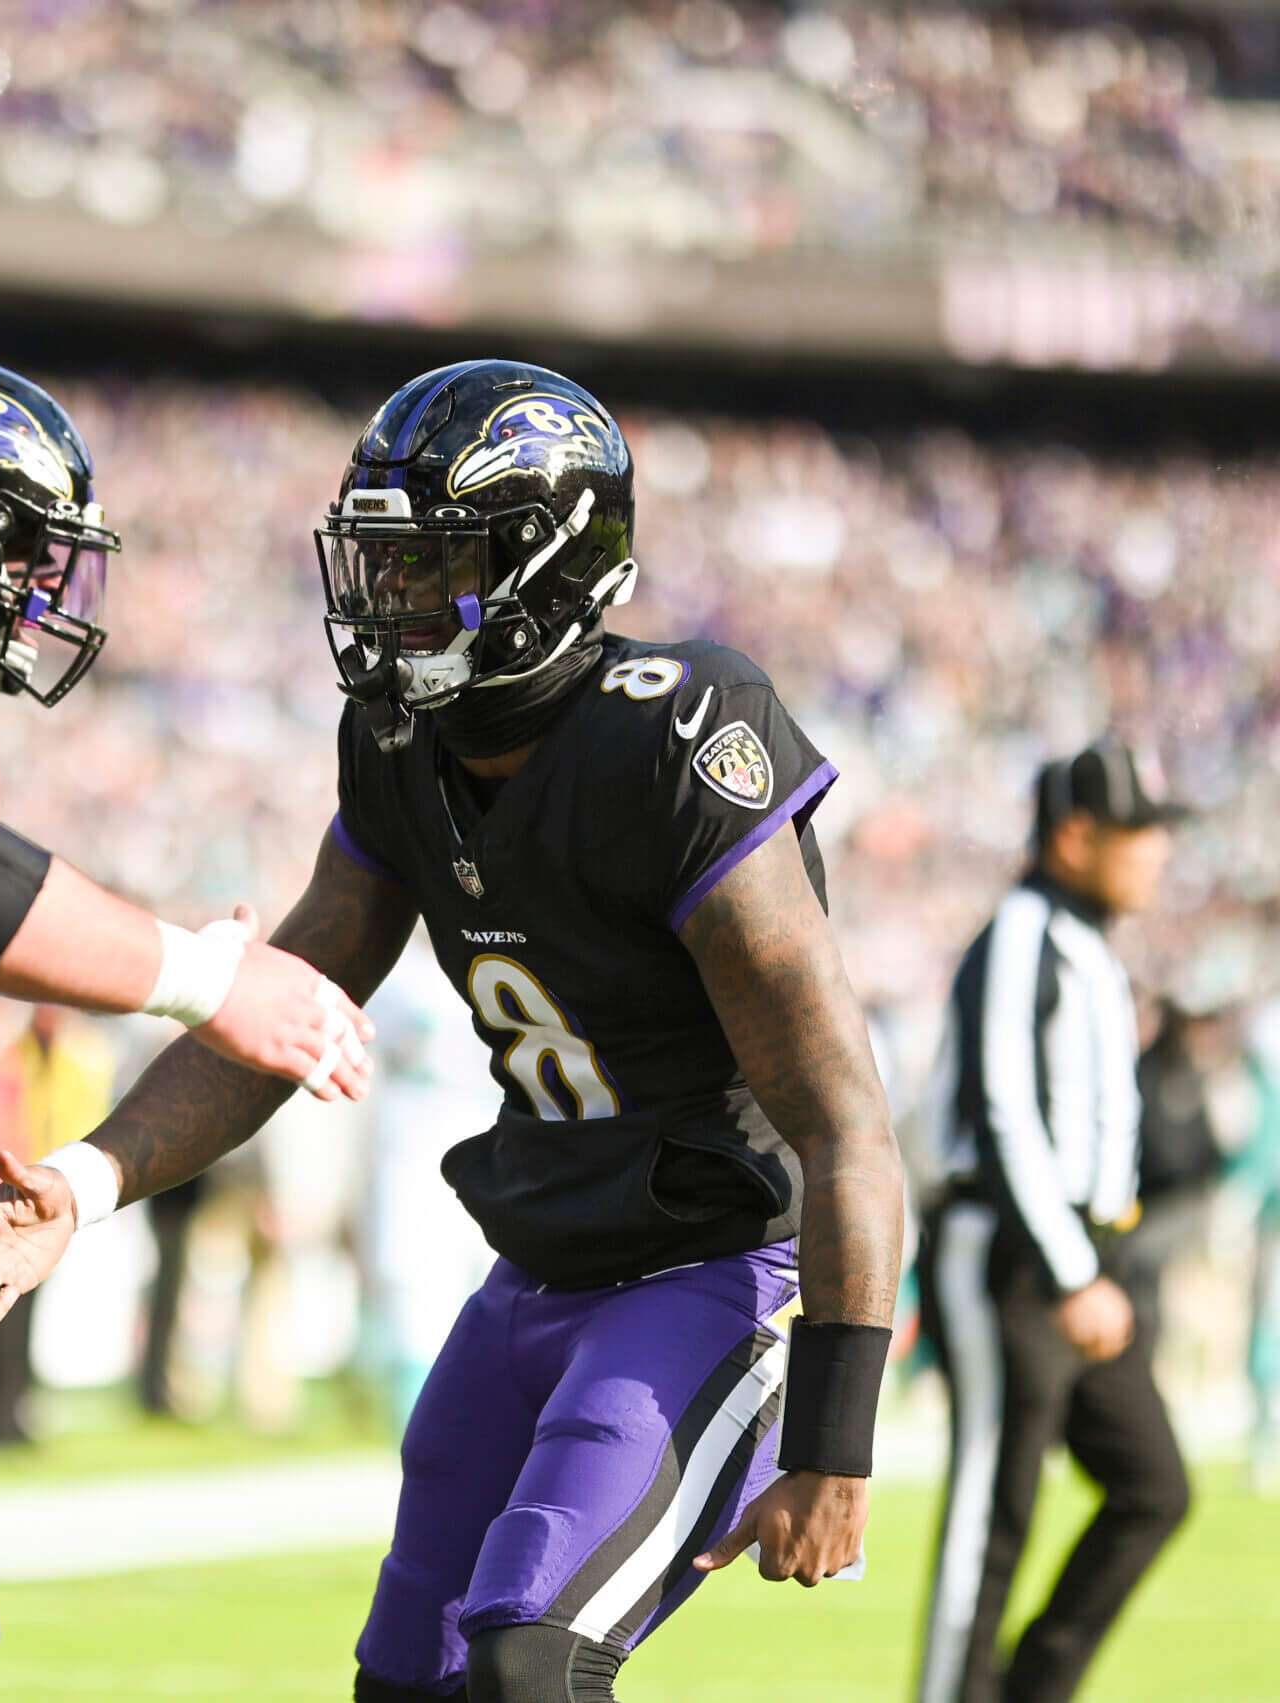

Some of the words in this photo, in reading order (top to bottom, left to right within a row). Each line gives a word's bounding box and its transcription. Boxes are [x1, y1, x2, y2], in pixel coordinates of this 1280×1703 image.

[601, 656, 688, 700] 8
[460, 929, 527, 944] RAVENS
[468, 953, 622, 1121] 8
